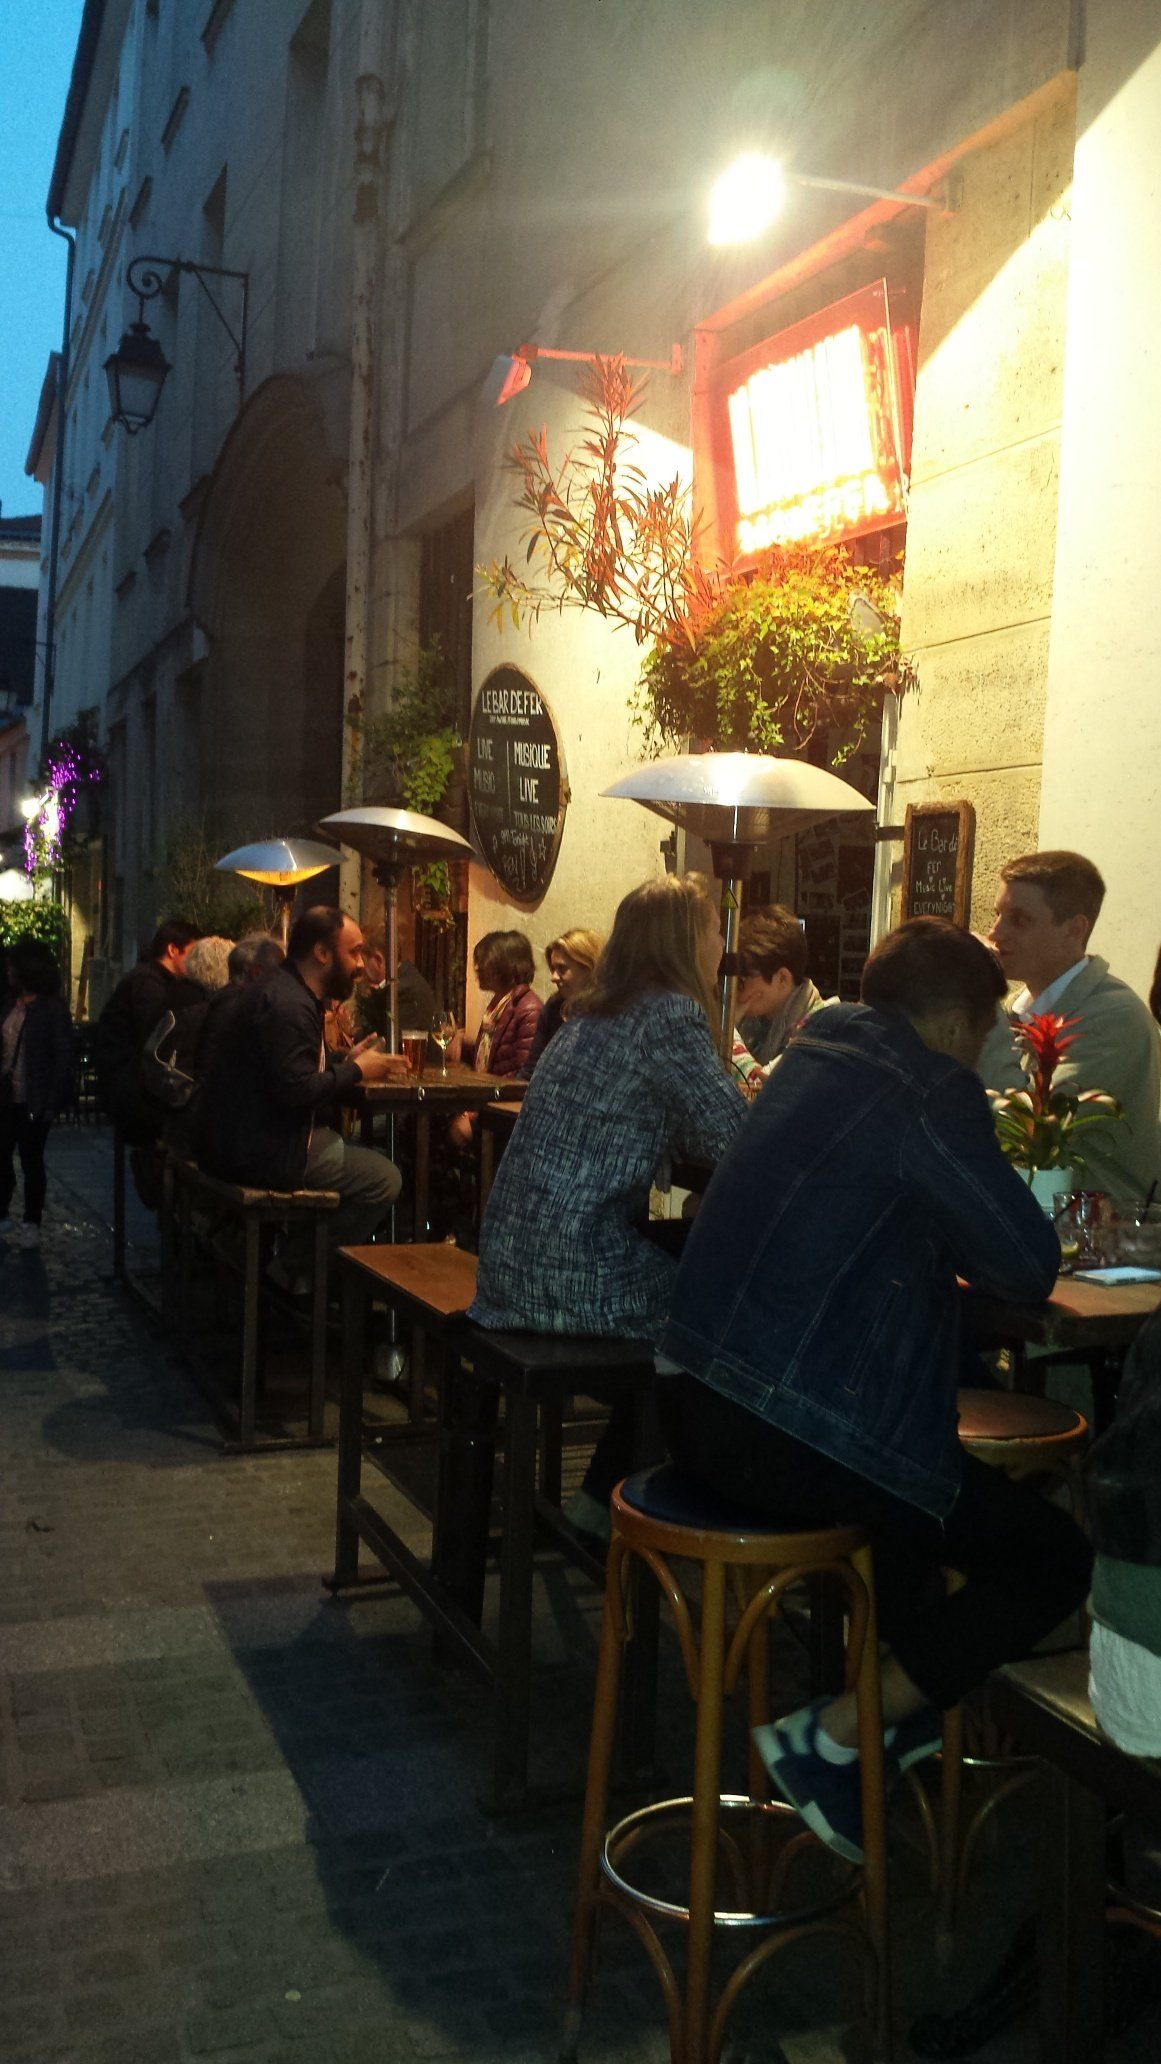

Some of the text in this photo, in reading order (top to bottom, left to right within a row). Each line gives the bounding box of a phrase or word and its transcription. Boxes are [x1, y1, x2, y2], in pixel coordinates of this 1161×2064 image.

[492, 689, 509, 714] BAR
[524, 691, 543, 715] FER
[477, 738, 493, 760] LIVE
[514, 741, 551, 770] MUSIQUE
[473, 767, 496, 793] MUSIC
[519, 776, 539, 804] LIVE
[918, 832, 928, 851] Le
[931, 829, 948, 853] Bar
